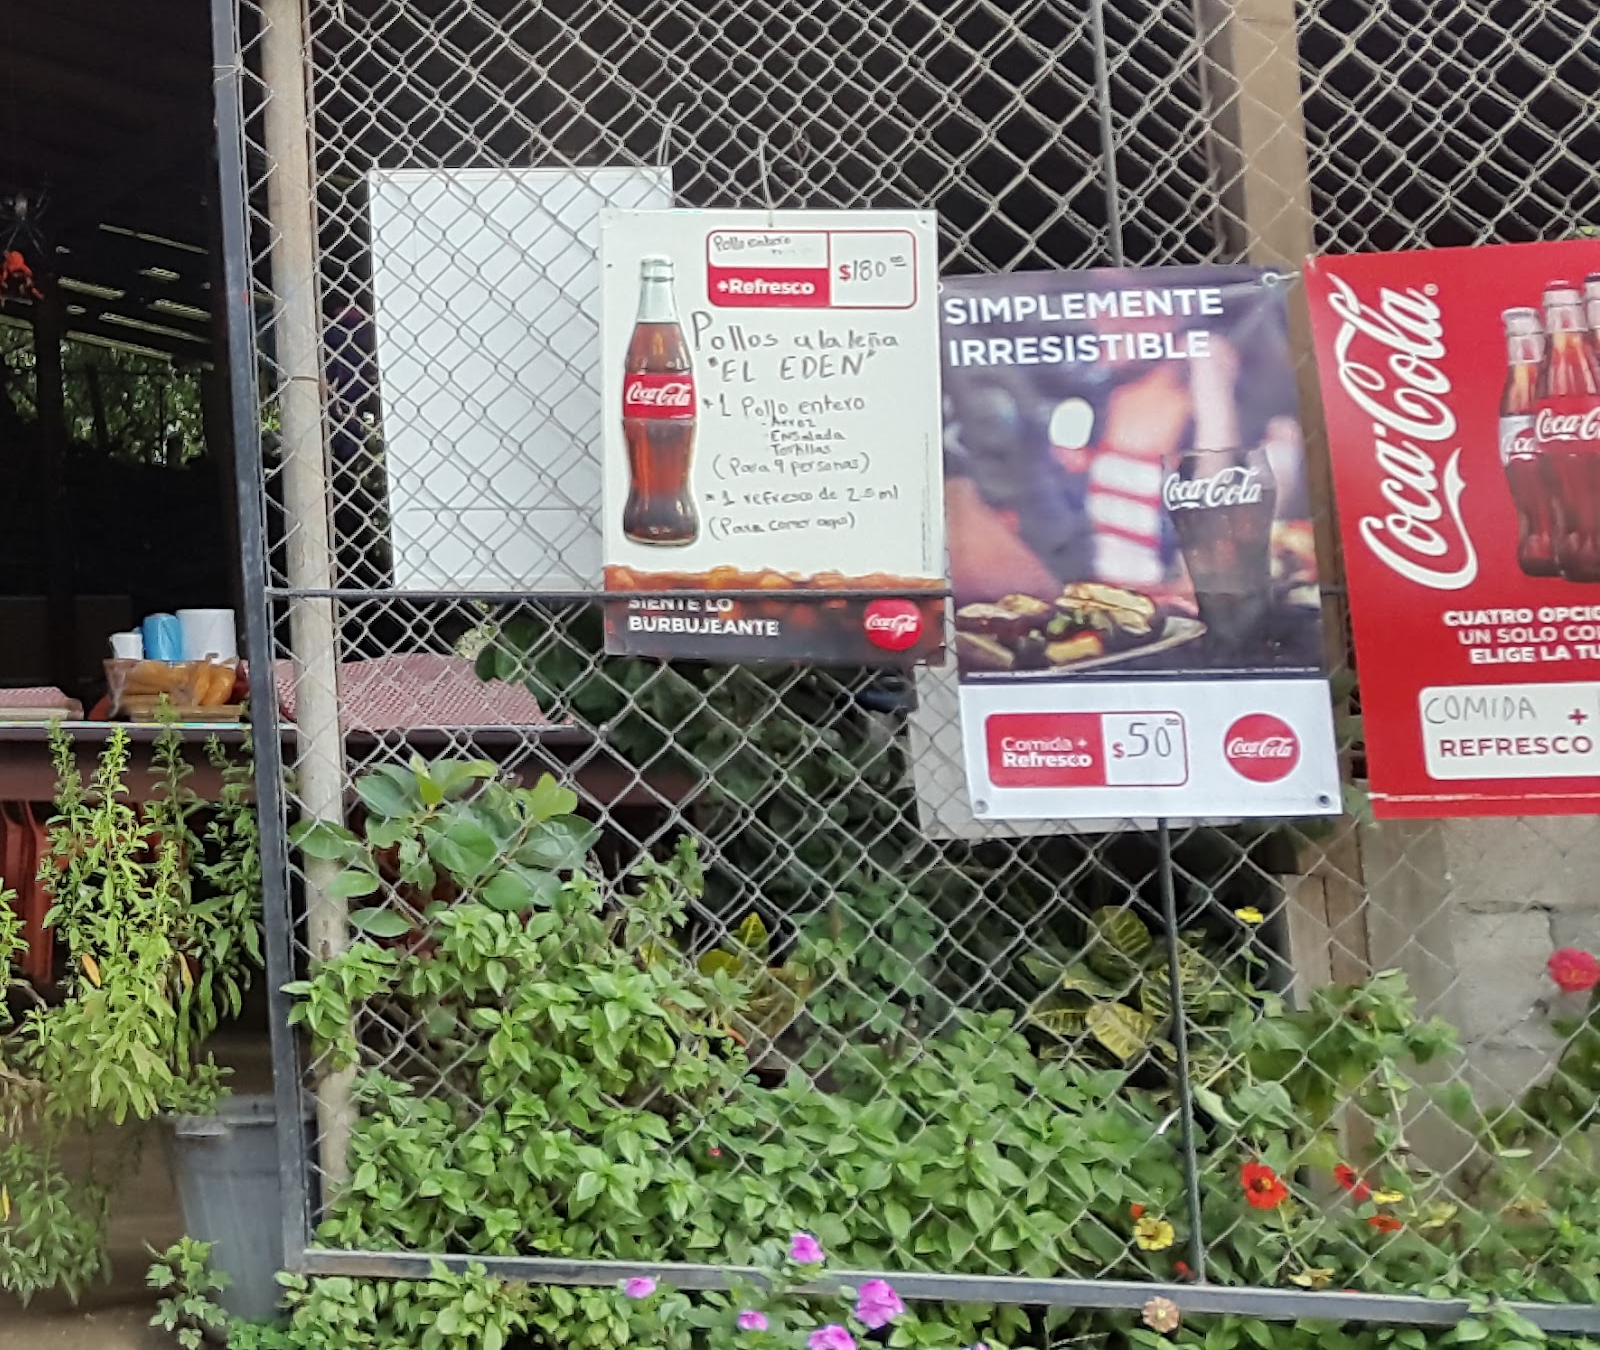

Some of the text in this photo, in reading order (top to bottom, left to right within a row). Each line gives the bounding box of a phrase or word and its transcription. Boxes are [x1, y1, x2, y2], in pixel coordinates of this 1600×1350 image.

[944, 288, 1224, 325] SIMPLEMENTE
[691, 310, 779, 351] Pollos
[949, 330, 1212, 367] IRRESISTIBLE
[741, 396, 788, 423] Pollo
[798, 395, 866, 415] entero
[1326, 271, 1479, 591] Coca-Cola
[1162, 466, 1263, 511] Coca-Cola
[627, 598, 734, 613] SIENTE LO
[1443, 608, 1534, 626] CUATRO
[628, 615, 780, 637] BURBUJEANTE
[1458, 629, 1492, 645] UN
[1497, 626, 1558, 643] SOLO
[1469, 647, 1536, 665] ELIGE
[1540, 645, 1571, 661] LA
[1423, 693, 1537, 725] COMIDA
[1001, 735, 1073, 752] Comida
[1438, 735, 1593, 758] REFRESCO
[1002, 752, 1093, 767] Refresco
